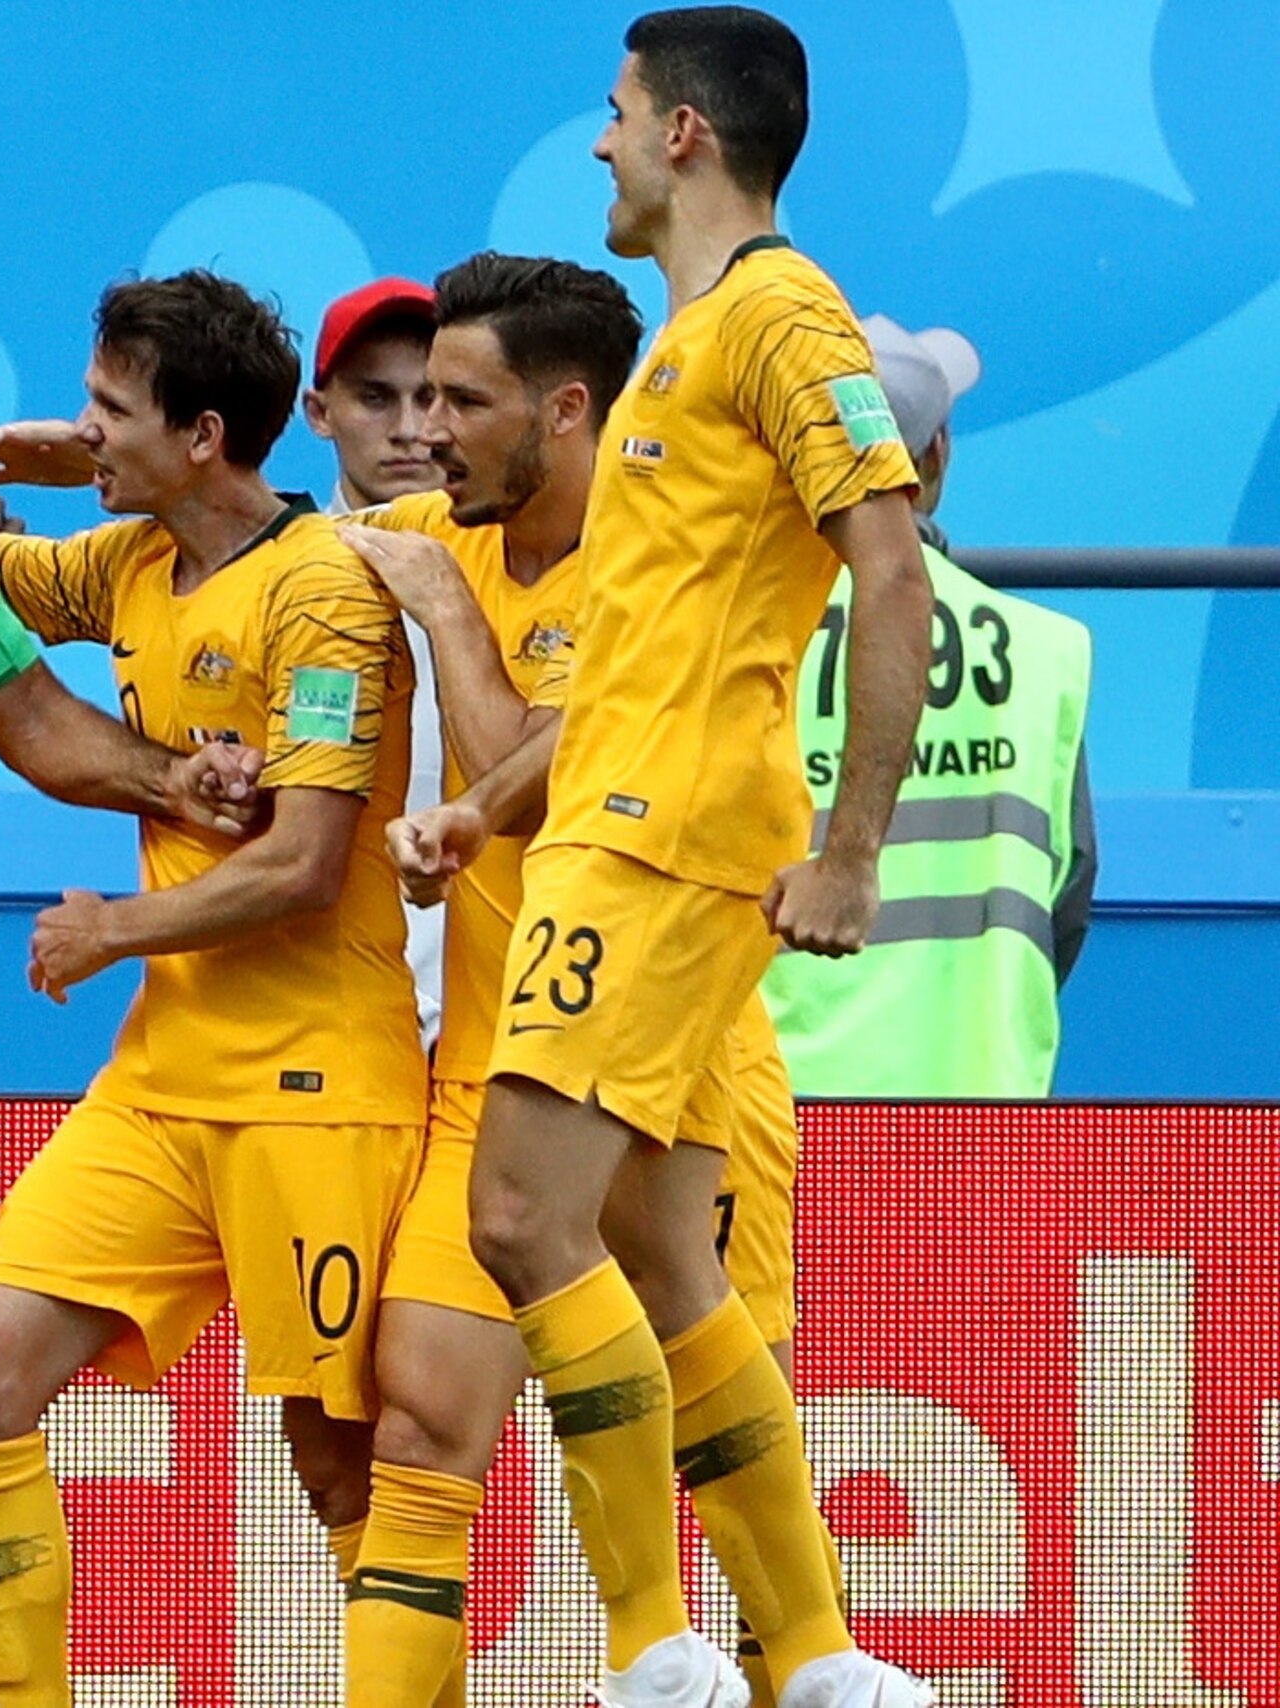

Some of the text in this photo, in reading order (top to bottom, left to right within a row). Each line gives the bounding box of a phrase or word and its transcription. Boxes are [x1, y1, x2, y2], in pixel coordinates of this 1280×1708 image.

[817, 598, 1013, 717] 793
[806, 737, 1016, 787] SWARD
[509, 916, 603, 1015] 23
[292, 1236, 360, 1340] 10
